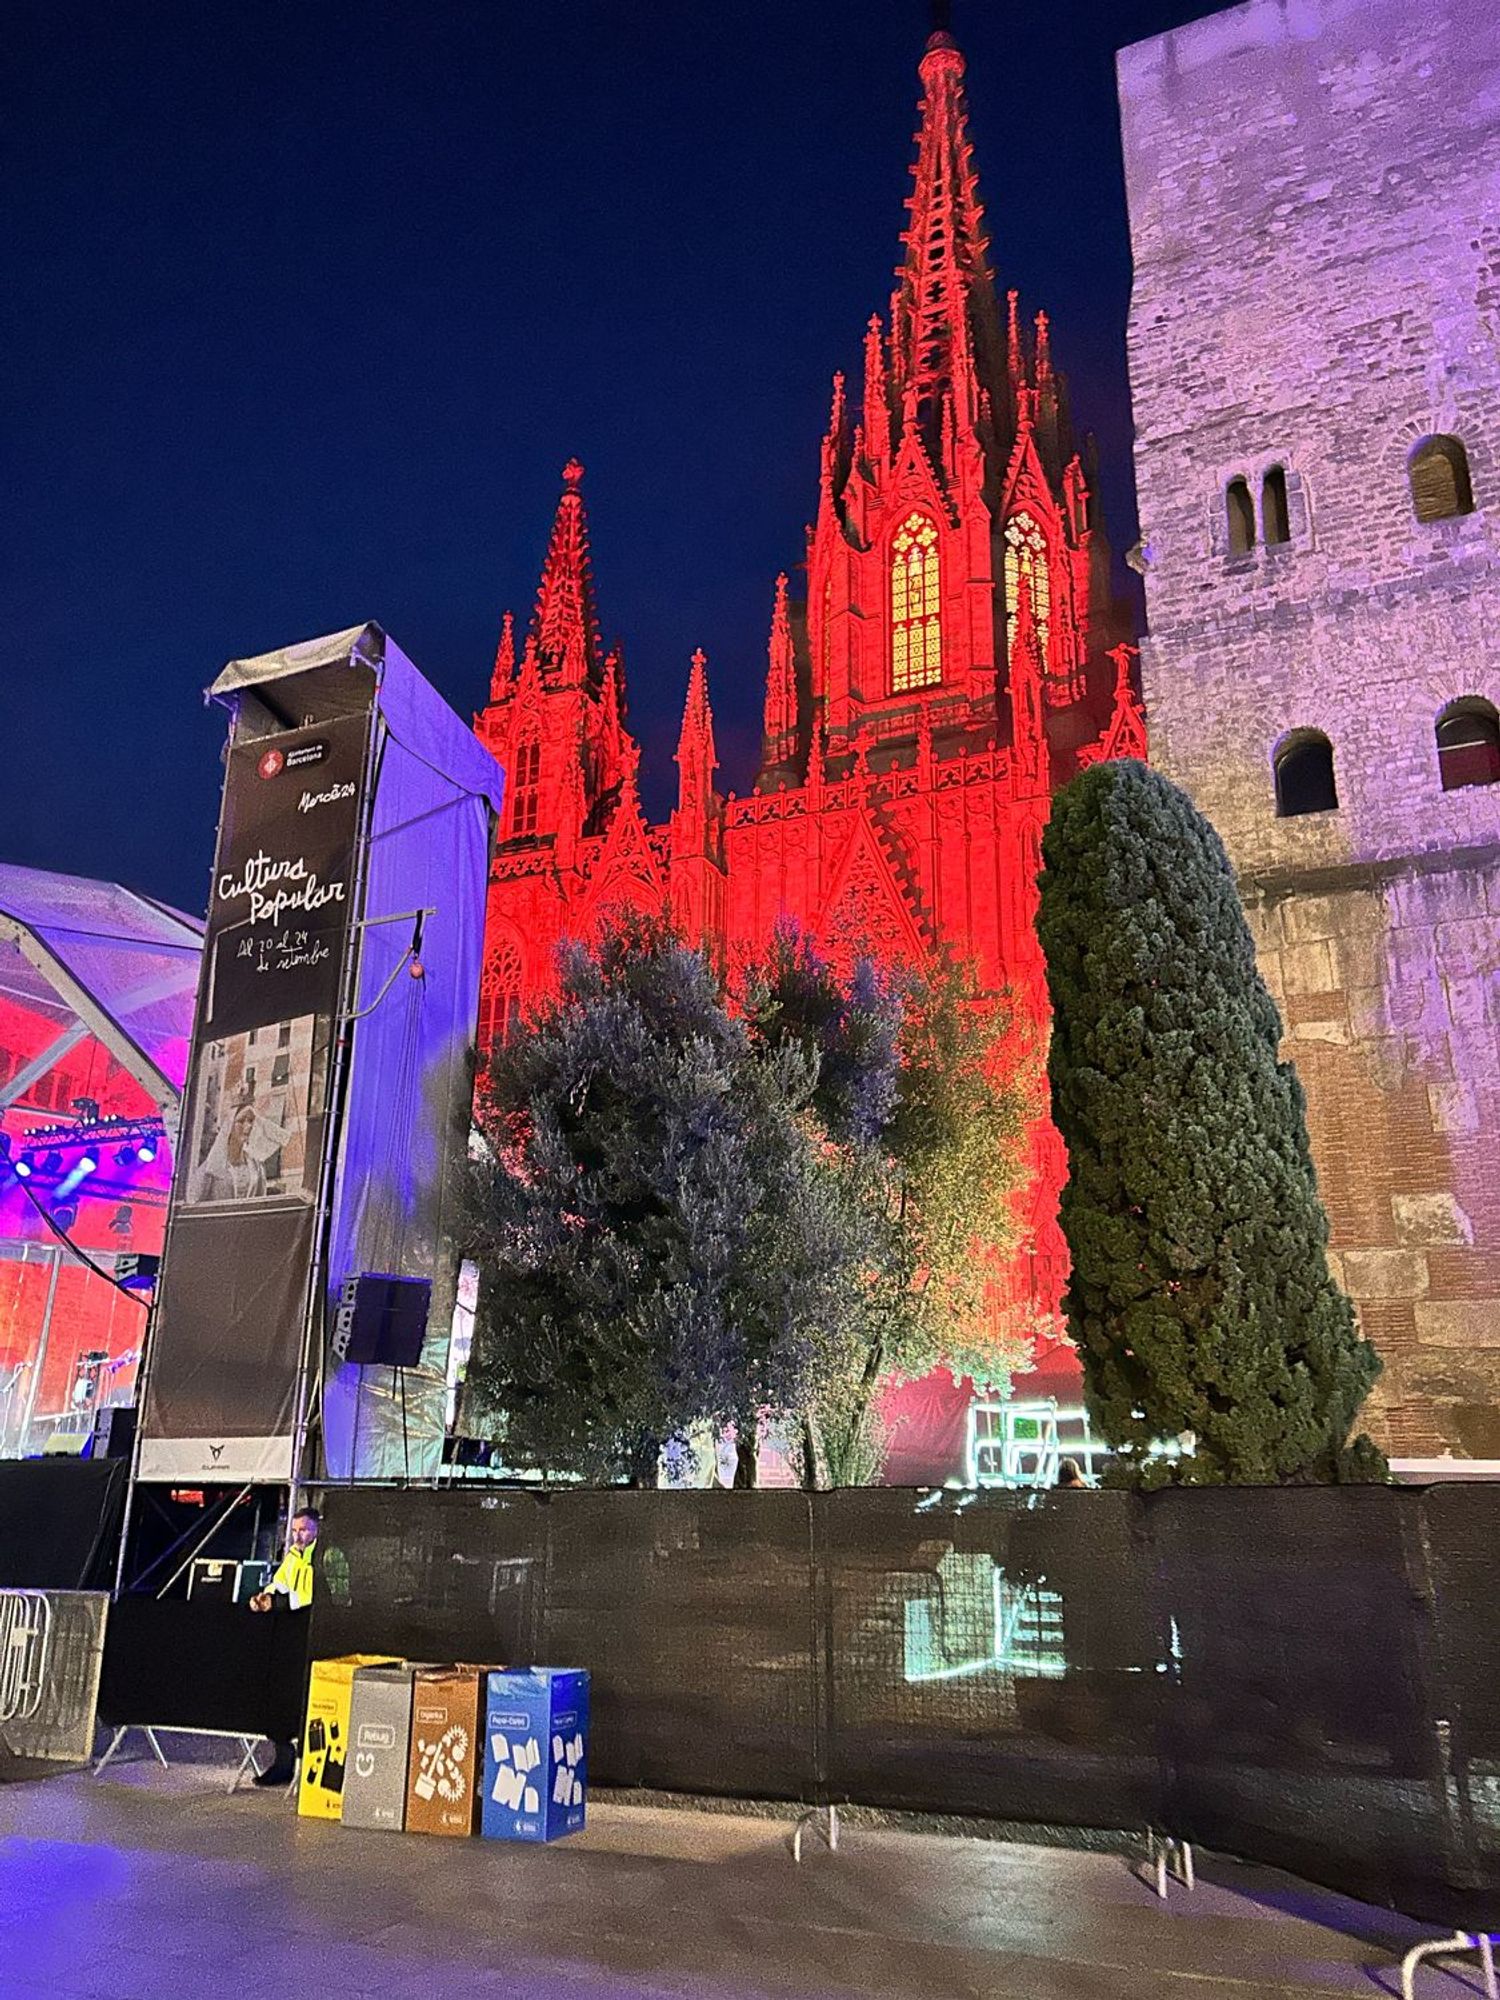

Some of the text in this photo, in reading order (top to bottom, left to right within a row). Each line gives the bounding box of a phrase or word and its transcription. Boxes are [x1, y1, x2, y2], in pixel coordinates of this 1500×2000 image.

[286, 752, 322, 767] Barcelona
[218, 849, 308, 900] Cultura
[249, 873, 345, 927] Popular
[256, 940, 330, 973] de setembre
[259, 938, 273, 952] 20
[294, 931, 308, 946] 24
